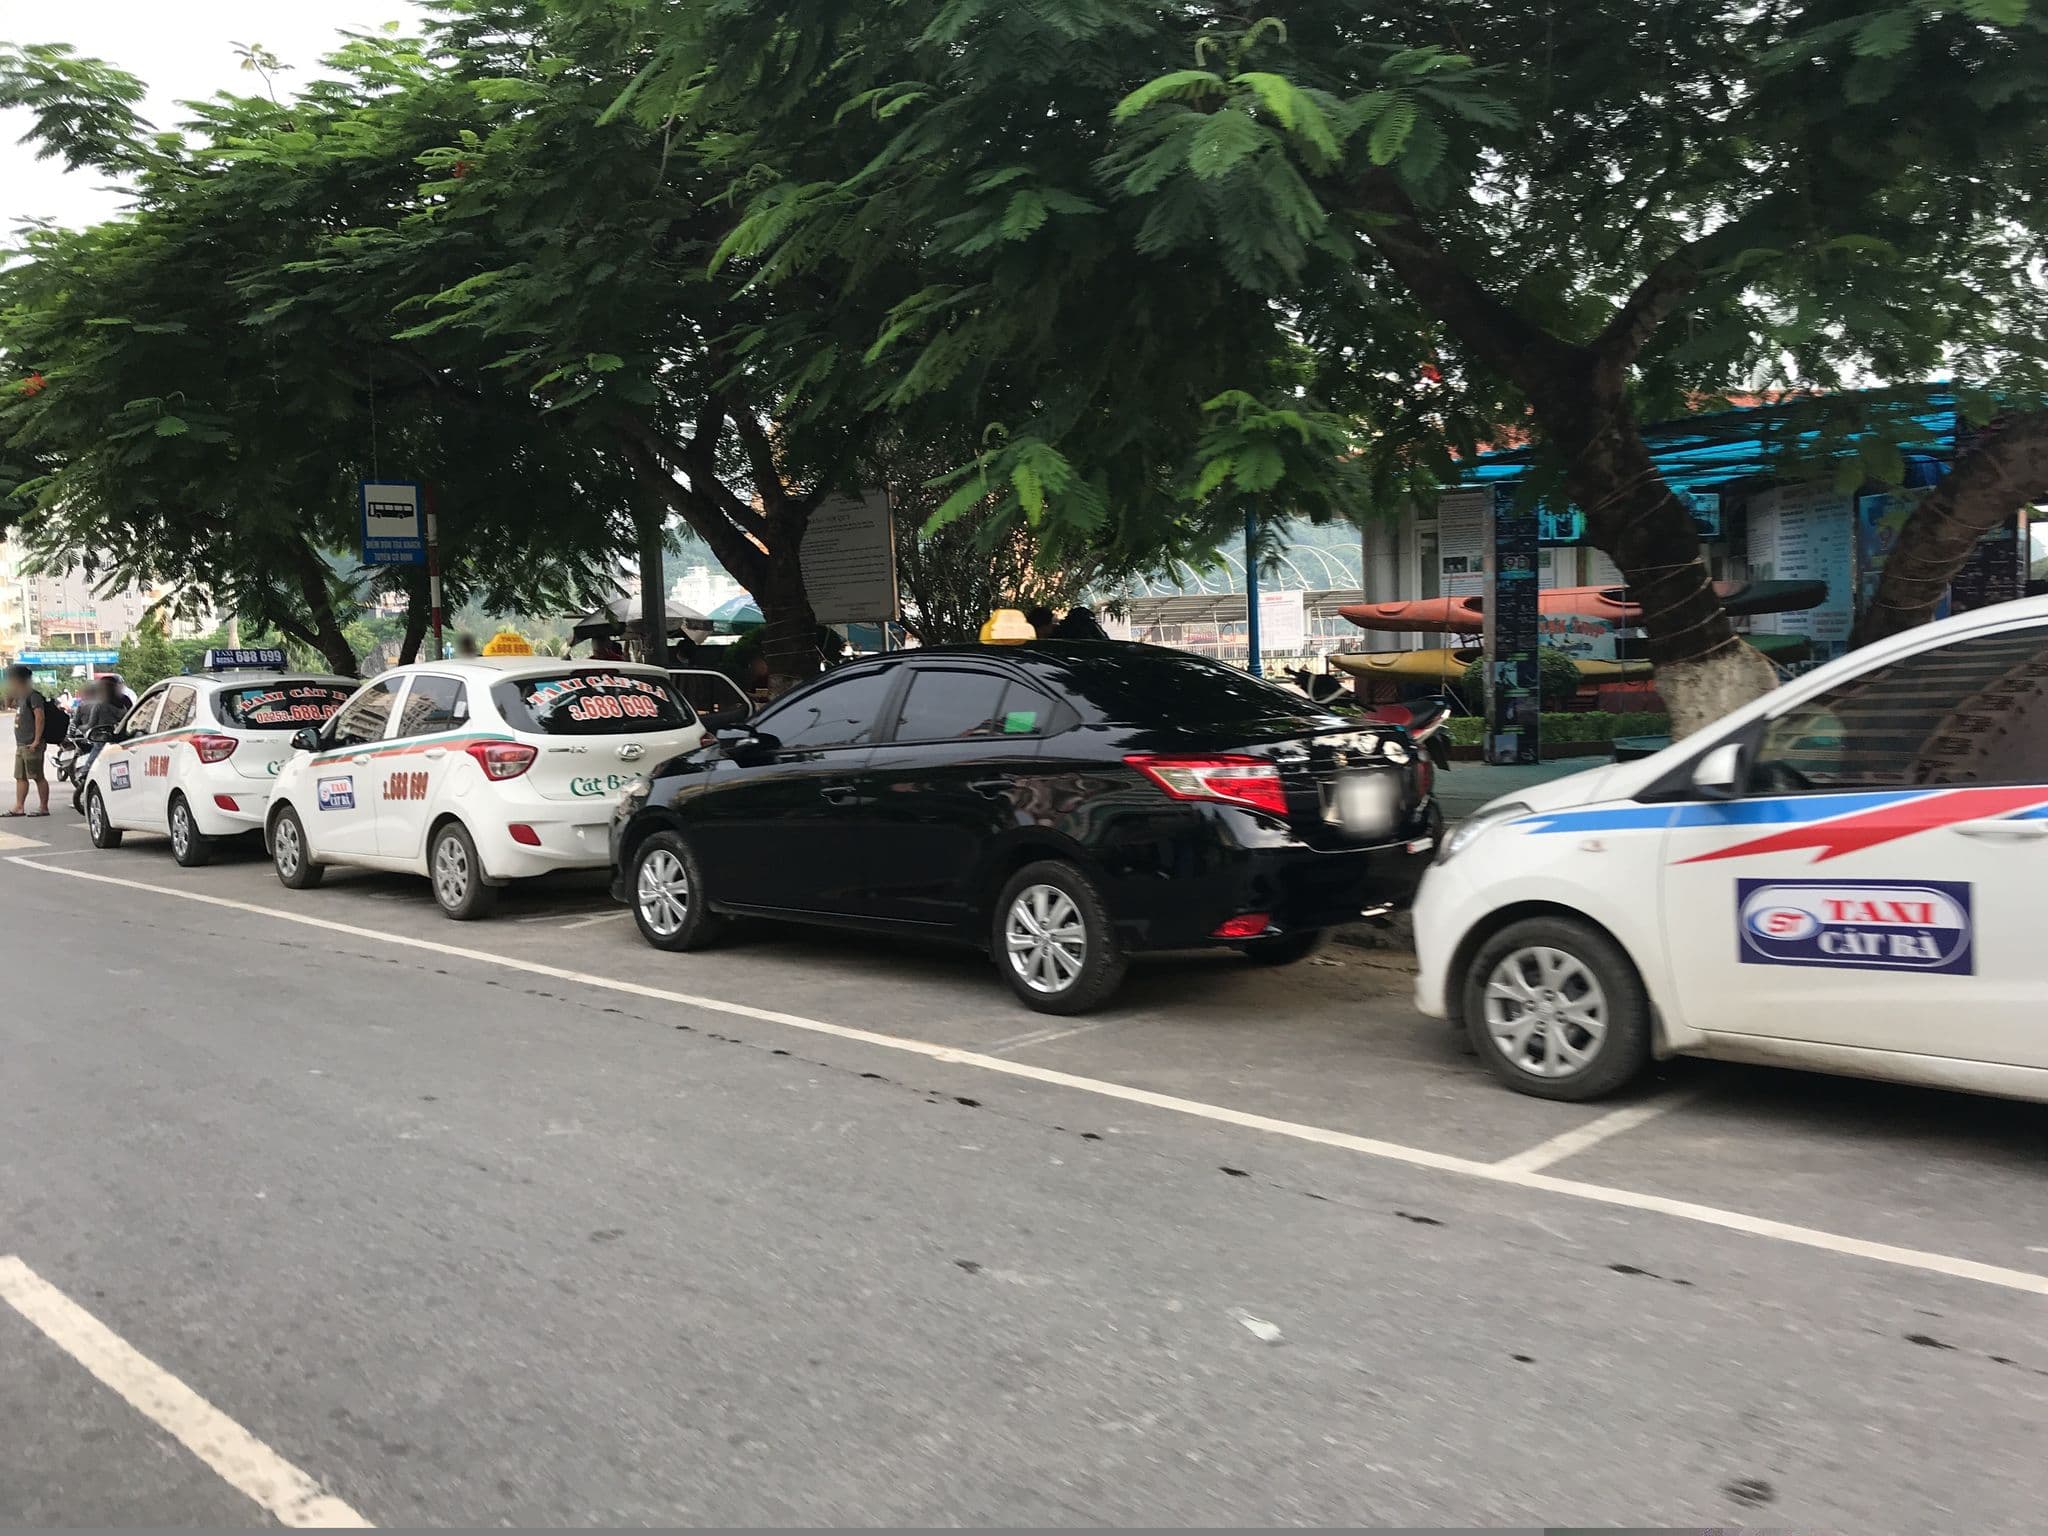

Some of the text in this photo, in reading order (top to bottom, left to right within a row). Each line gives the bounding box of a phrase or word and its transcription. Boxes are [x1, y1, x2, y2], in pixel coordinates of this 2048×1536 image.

[235, 650, 282, 662] 688 699
[240, 691, 286, 711] TAXI
[526, 677, 587, 706] TAXI
[568, 694, 658, 721] 3.688 699
[1822, 899, 1936, 925] TAXI
